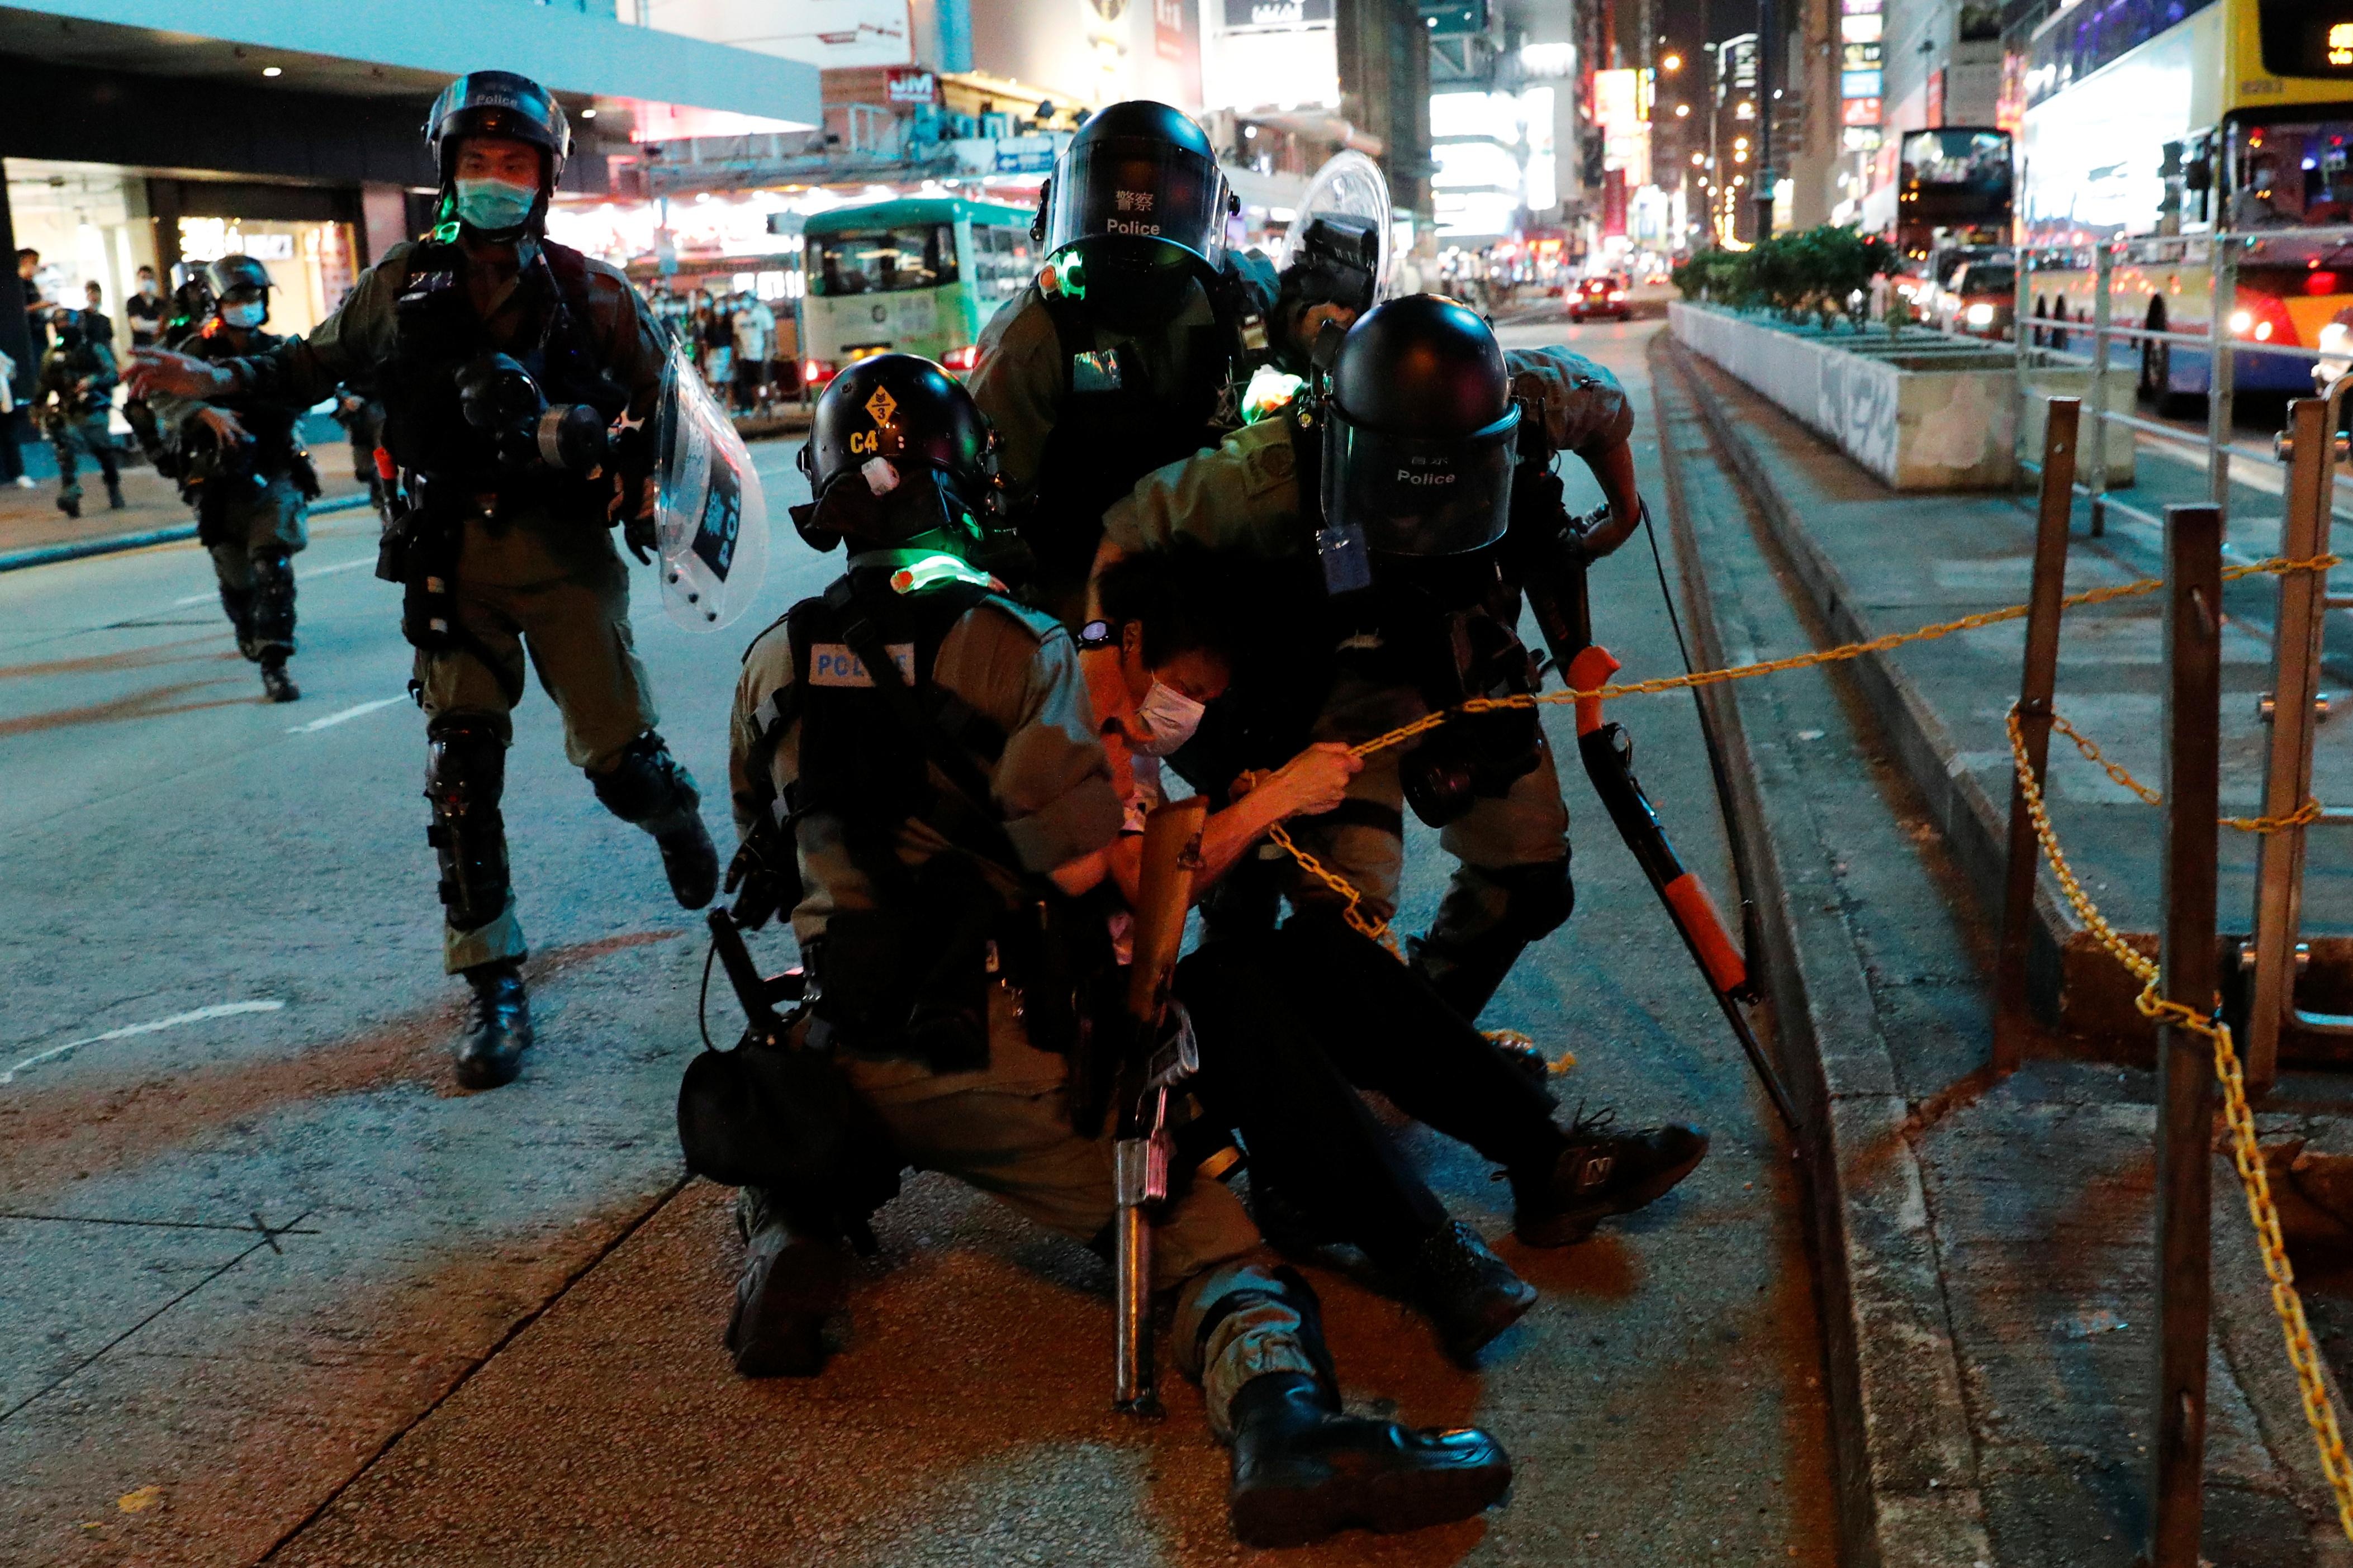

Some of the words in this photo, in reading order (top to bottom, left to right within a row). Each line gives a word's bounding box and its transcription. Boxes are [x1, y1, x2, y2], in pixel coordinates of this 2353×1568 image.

[476, 93, 518, 107] Police
[1115, 190, 1154, 211] 警察
[1107, 218, 1160, 235] Police
[850, 430, 879, 454] C4
[1397, 468, 1455, 485] Police
[718, 471, 740, 569] POLI
[818, 653, 907, 678] POLE
